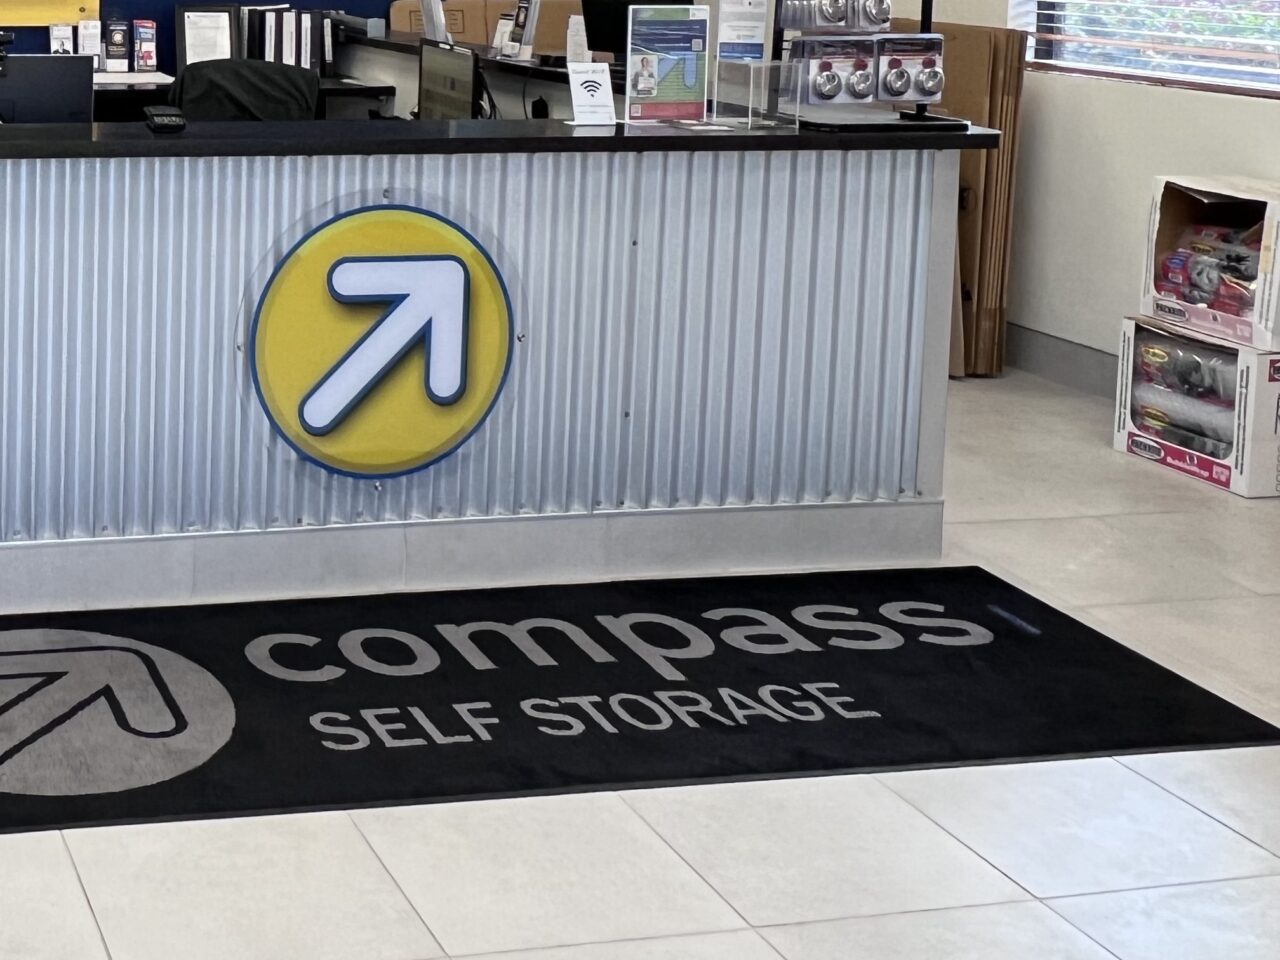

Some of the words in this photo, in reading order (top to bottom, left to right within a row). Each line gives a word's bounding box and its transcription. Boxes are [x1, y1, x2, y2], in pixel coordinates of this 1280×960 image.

[245, 600, 995, 682] compass
[308, 700, 501, 751] SELF
[520, 681, 882, 737] STORAGE
